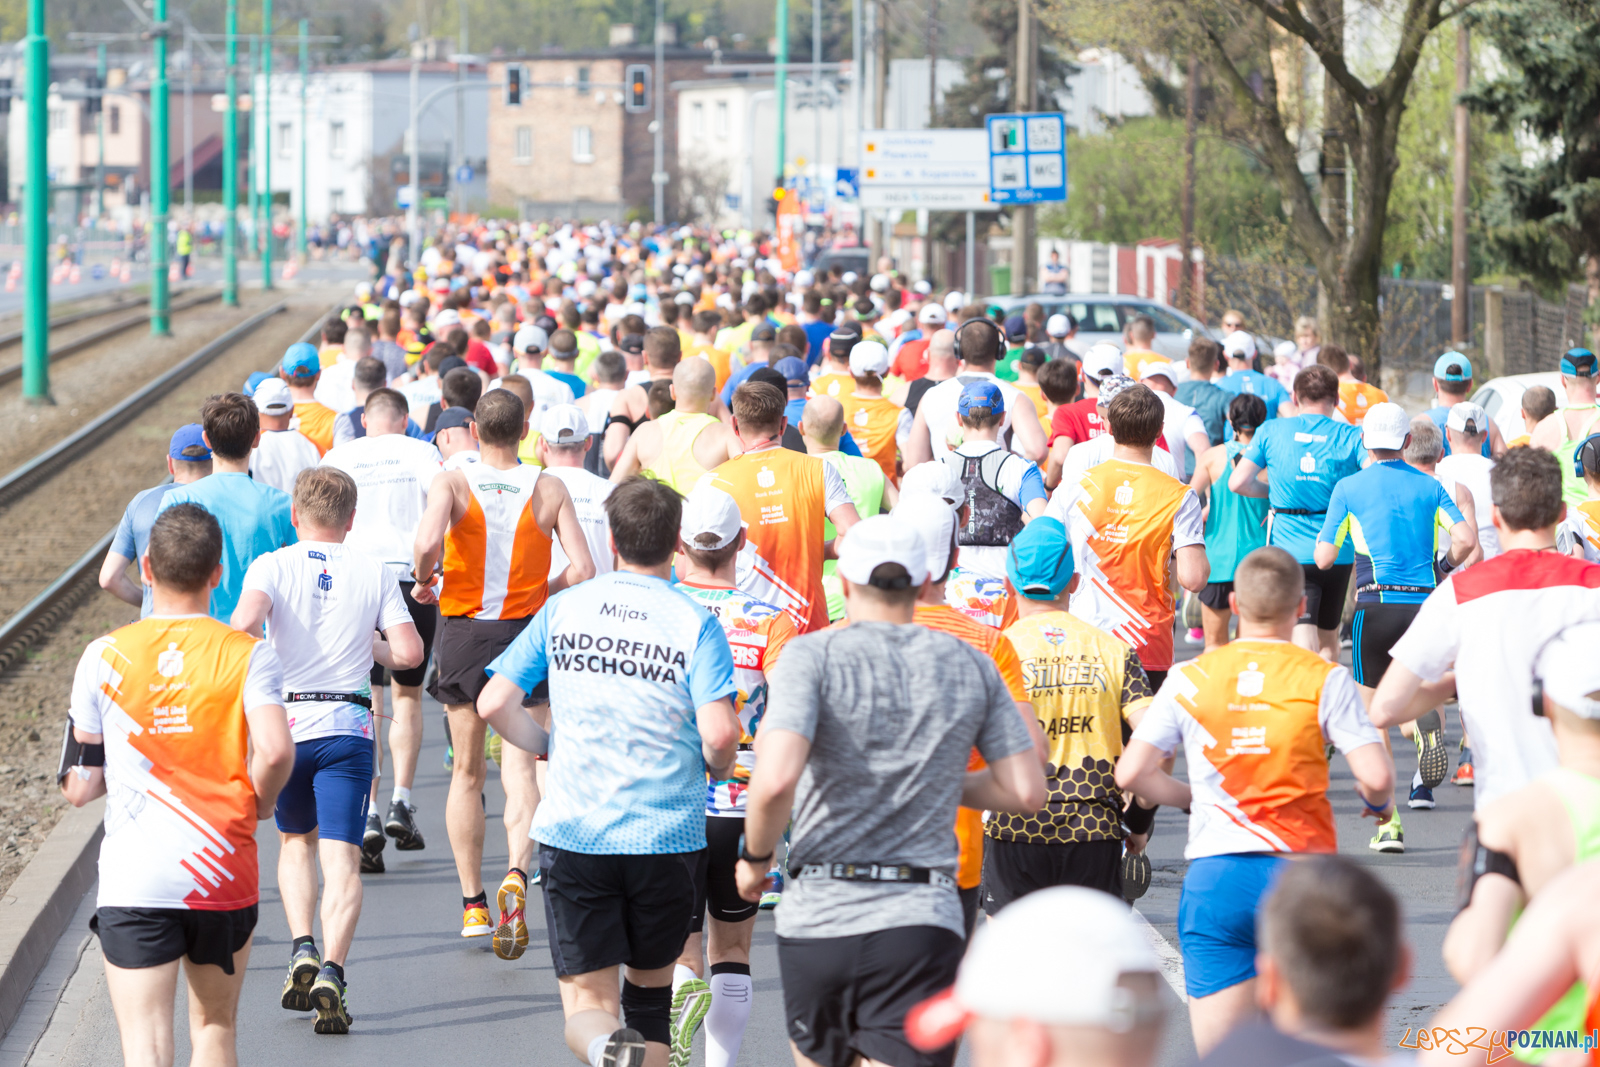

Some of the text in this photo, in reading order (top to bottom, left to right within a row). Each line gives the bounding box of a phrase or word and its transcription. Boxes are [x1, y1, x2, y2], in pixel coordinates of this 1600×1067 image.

[600, 602, 648, 622] Mijas
[554, 653, 678, 685] WSCHOWA
[1039, 654, 1102, 664] HONEY
[1020, 657, 1107, 693] STINGER
[1027, 687, 1099, 698] UNNERS
